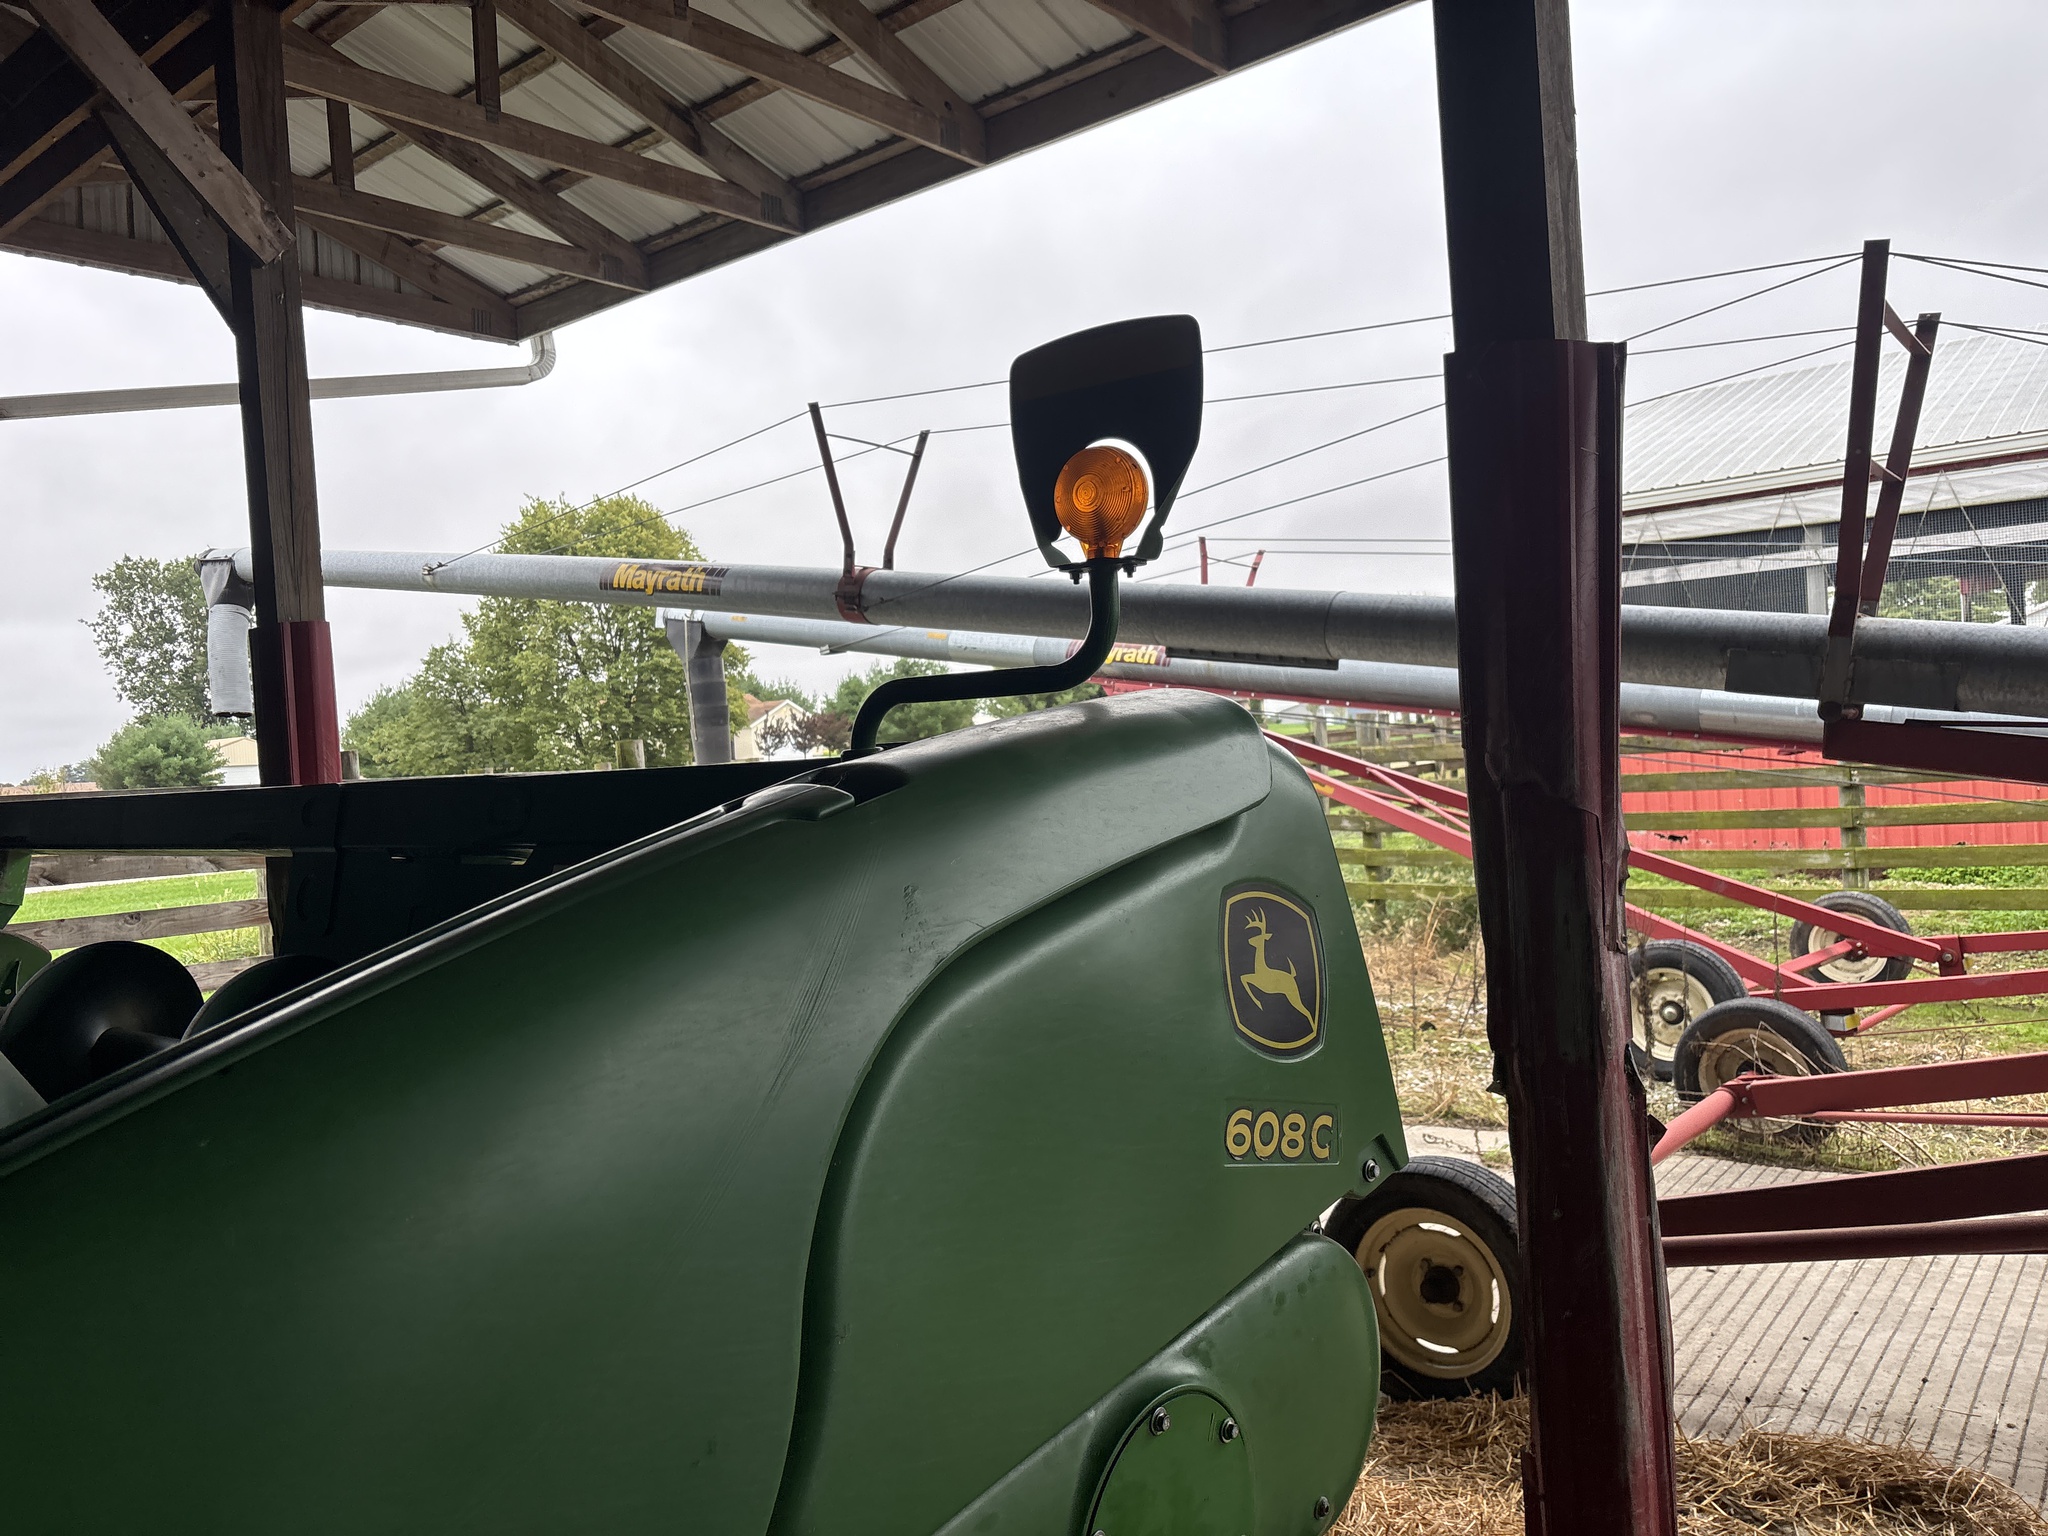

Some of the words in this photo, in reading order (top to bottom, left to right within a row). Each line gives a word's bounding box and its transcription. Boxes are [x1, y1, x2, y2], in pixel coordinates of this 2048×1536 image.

[612, 564, 706, 596] Mayrath
[1104, 644, 1158, 665] yrath
[1225, 1107, 1334, 1162] 608C
